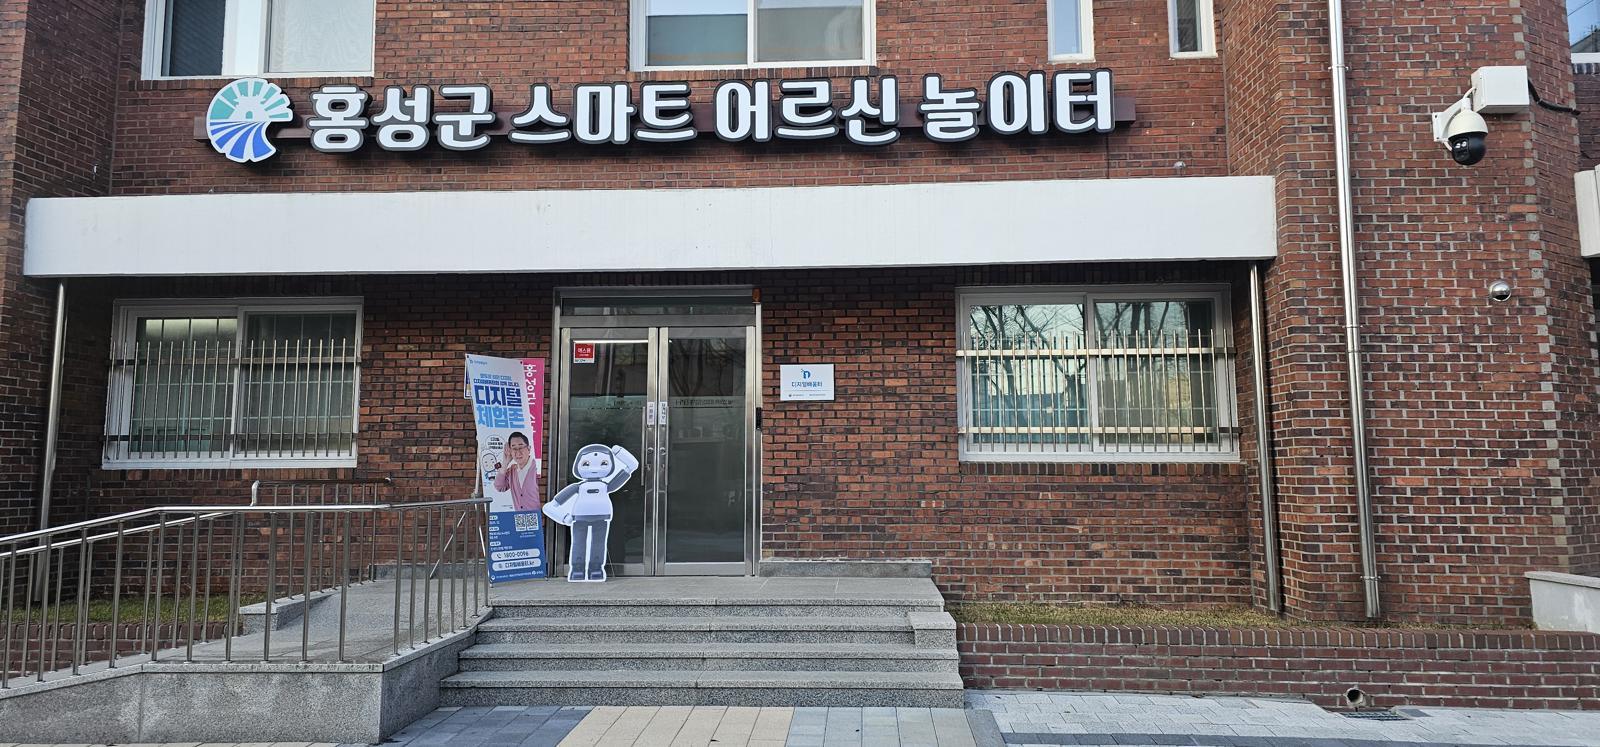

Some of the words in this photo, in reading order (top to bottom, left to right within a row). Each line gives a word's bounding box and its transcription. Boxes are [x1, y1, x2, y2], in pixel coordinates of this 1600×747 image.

[307, 84, 496, 151] 홍성군
[508, 82, 697, 144] 스마트
[714, 74, 900, 144] 어르신
[919, 69, 1114, 142] 놀이터
[474, 384, 522, 407] 디지털
[476, 405, 525, 428] 체험존
